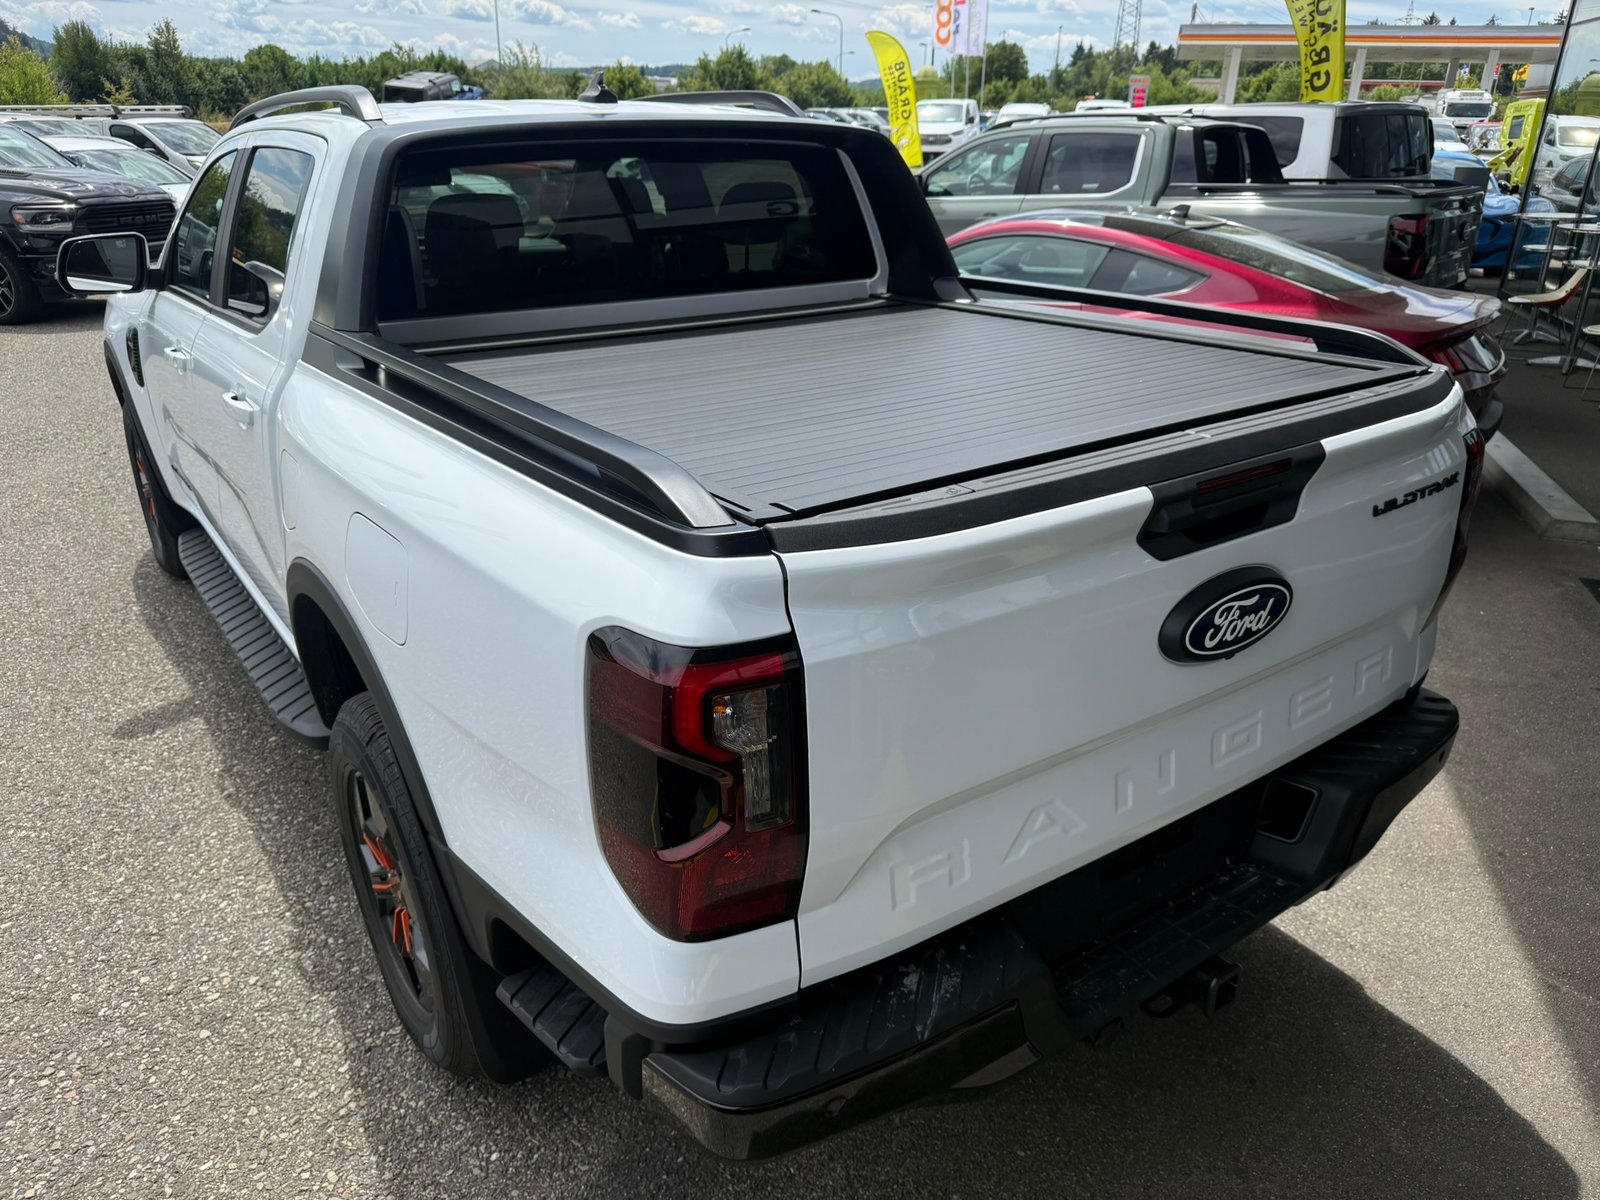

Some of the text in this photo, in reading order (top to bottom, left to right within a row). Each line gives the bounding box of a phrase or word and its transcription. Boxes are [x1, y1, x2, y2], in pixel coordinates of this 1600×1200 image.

[120, 214, 159, 225] RAM
[1373, 471, 1459, 517] WILDTRAK
[1204, 594, 1275, 648] Ford
[888, 645, 1394, 912] RANGER
